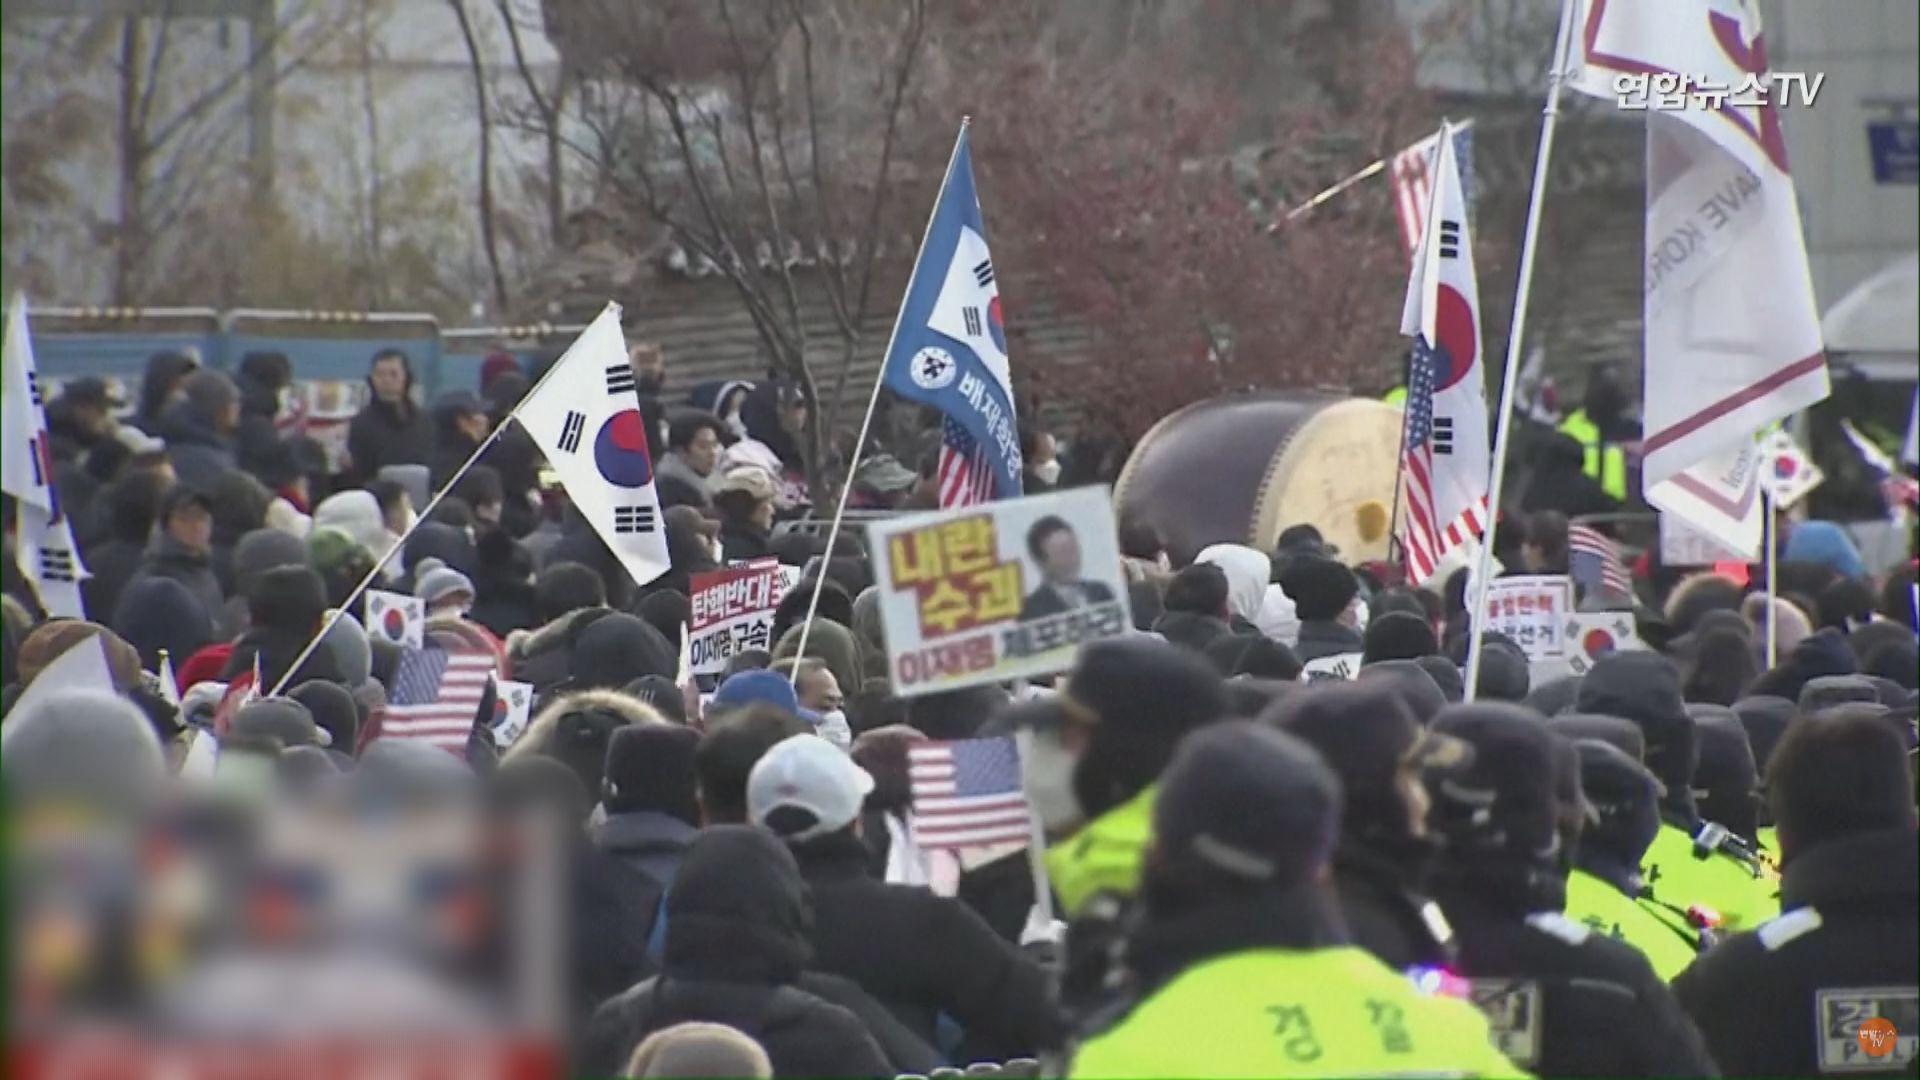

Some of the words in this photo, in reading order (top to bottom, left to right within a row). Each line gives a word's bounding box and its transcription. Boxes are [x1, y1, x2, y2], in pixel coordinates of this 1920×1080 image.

[889, 516, 991, 584] 내란
[691, 572, 772, 628] 탄핵반대
[921, 560, 1022, 632] 수괴
[733, 618, 768, 652] 구속
